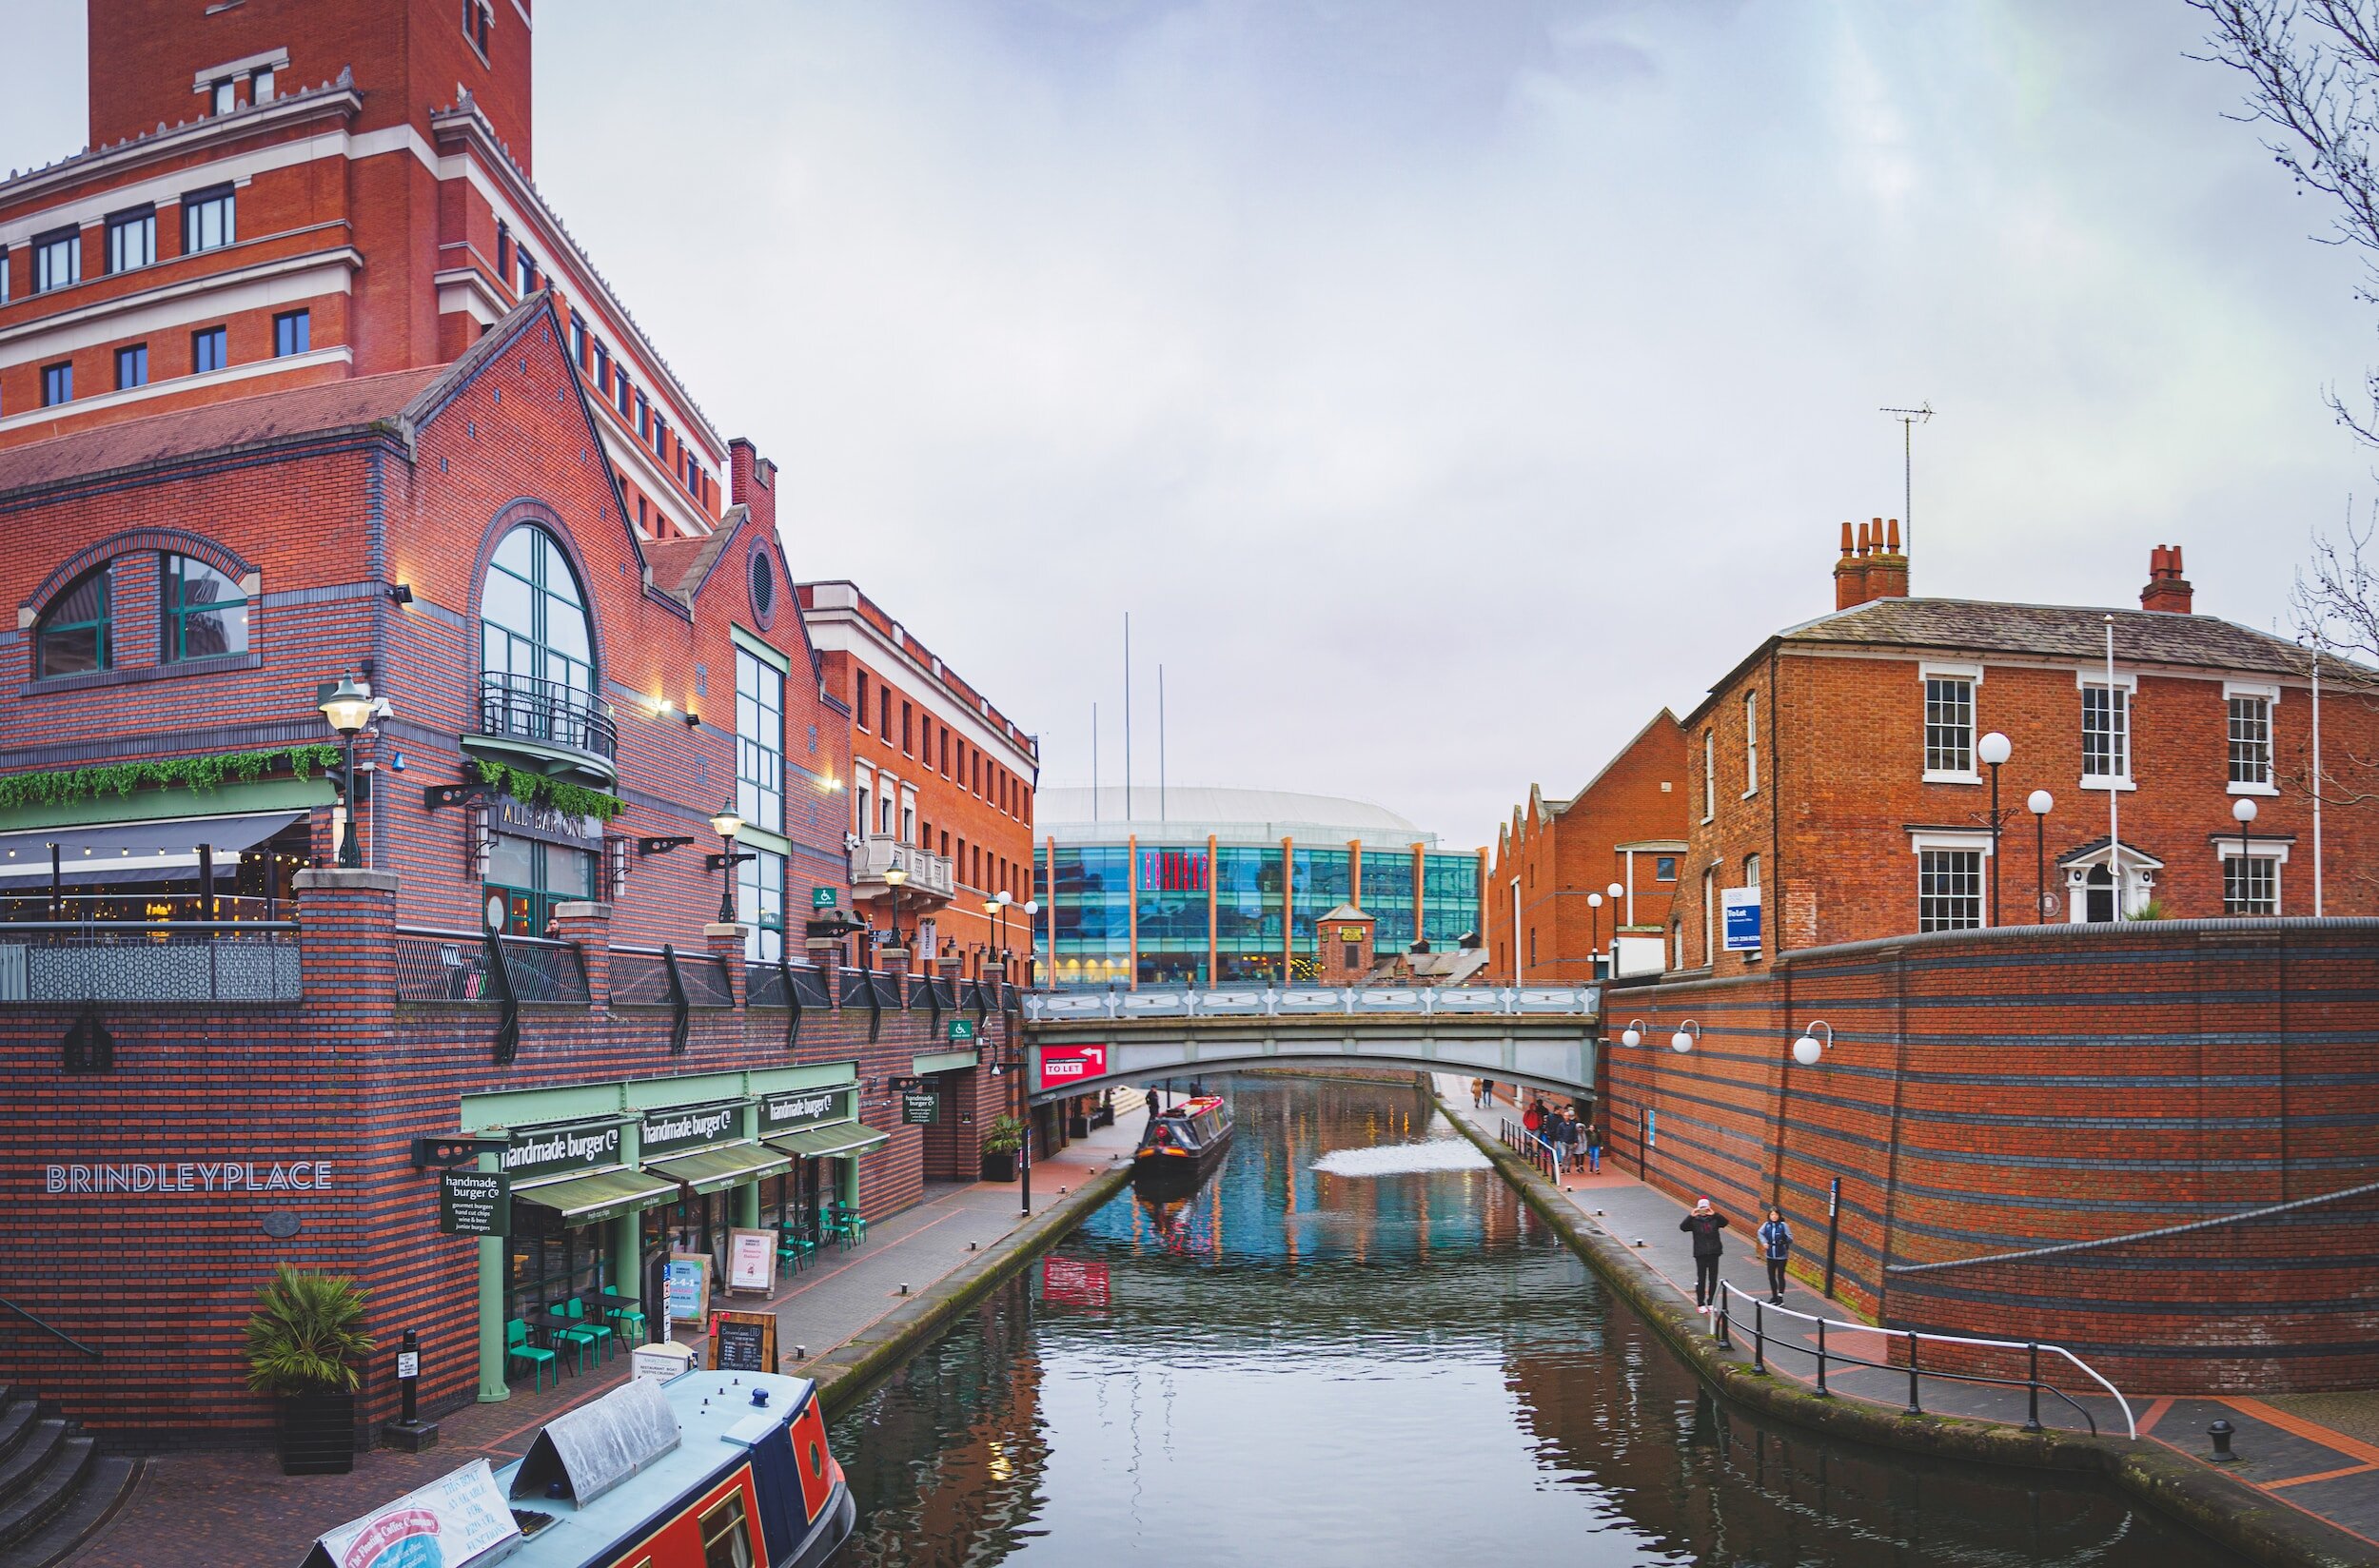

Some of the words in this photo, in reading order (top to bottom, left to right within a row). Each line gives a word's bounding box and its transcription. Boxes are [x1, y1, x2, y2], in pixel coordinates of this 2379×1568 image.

[503, 804, 527, 826] ALL
[770, 1099, 804, 1121] handmade
[804, 1098, 824, 1118] burger
[643, 1117, 692, 1145] handmade
[693, 1115, 720, 1139] burger
[567, 1131, 605, 1161] burger
[47, 1162, 332, 1193] BRINDLEYPLACE
[445, 1175, 498, 1187] handmade
[453, 1186, 486, 1200] burger
[671, 1278, 695, 1287] 2-4-1
[348, 1553, 363, 1568] The
[358, 1532, 385, 1557] Floating
[381, 1521, 404, 1537] Coffee
[403, 1517, 435, 1530] Company
[466, 1523, 507, 1553] FUNCTIONS
